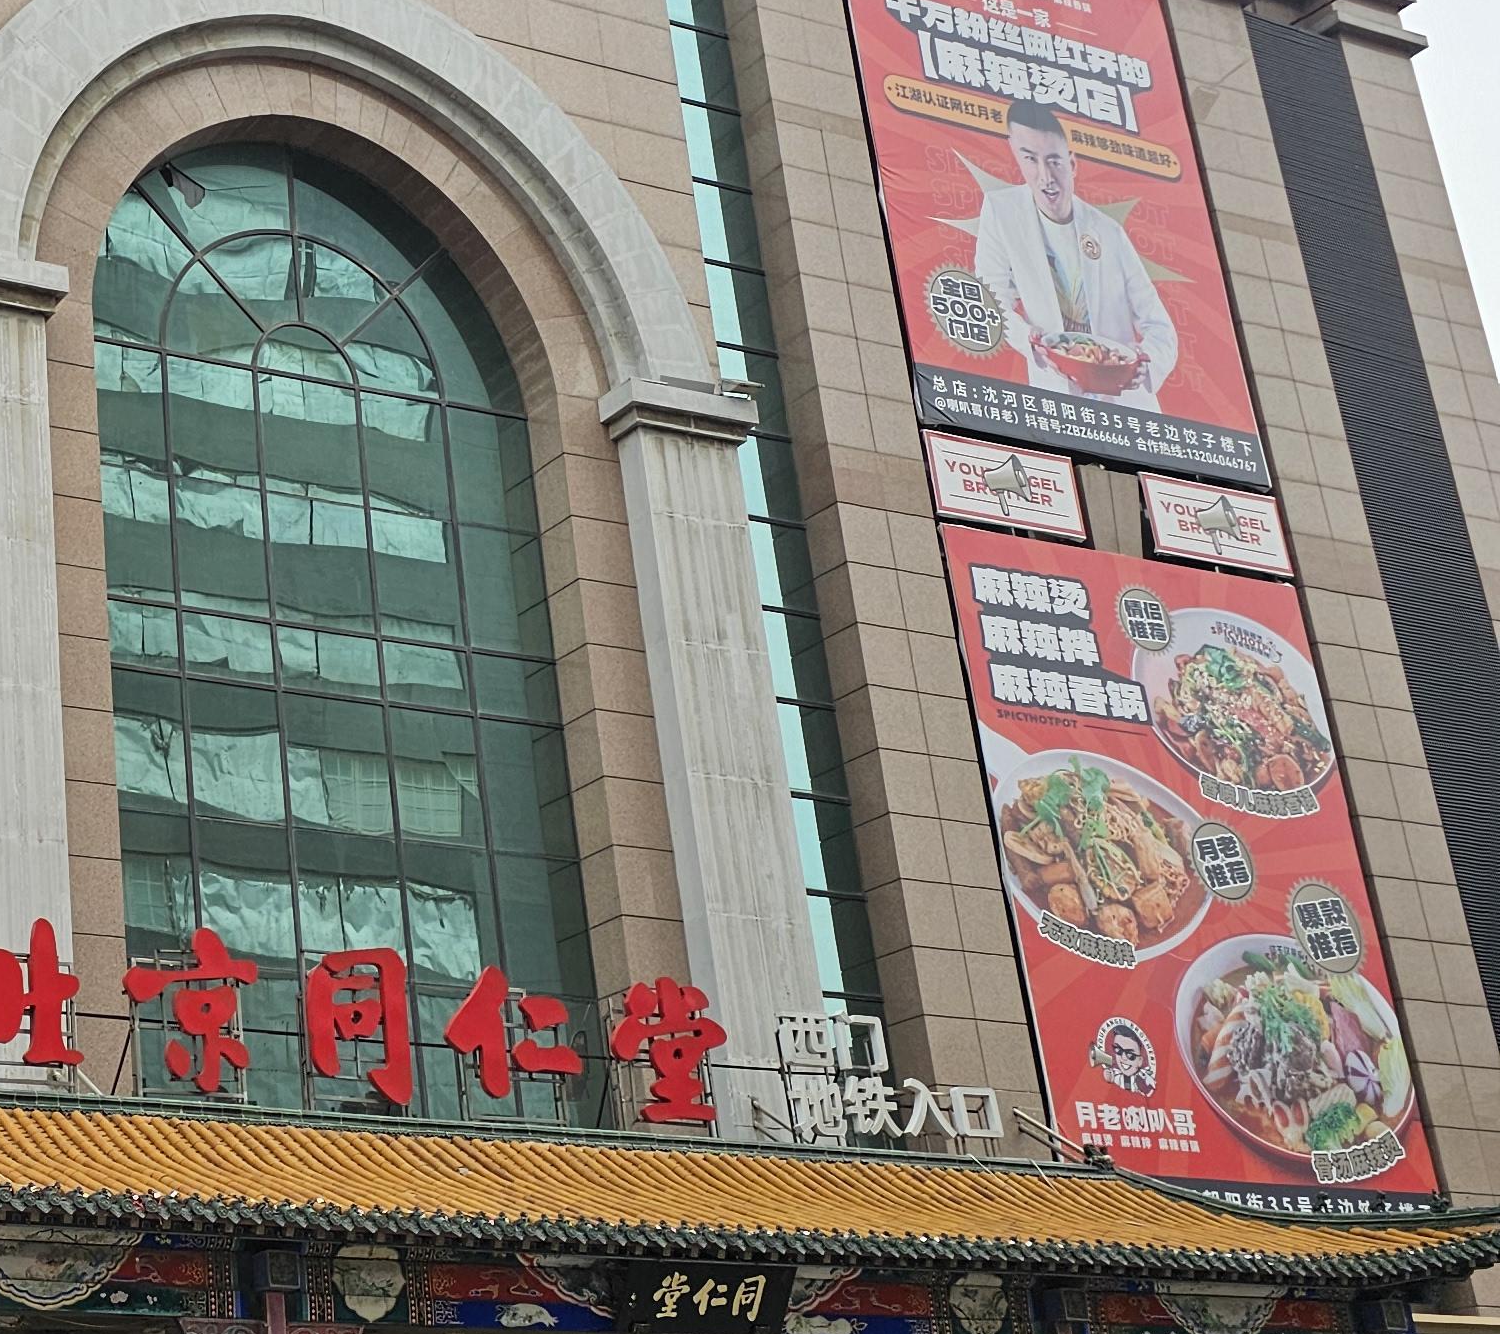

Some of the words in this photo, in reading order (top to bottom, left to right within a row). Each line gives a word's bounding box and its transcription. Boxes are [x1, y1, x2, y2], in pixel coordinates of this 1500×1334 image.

[939, 277, 982, 304] 全国
[932, 296, 1001, 326] 500+
[948, 319, 990, 344] 门店
[971, 567, 1089, 620] 麻辣烫
[980, 615, 1100, 666] 麻辣拌
[1128, 620, 1168, 642] 推荐
[990, 663, 1148, 722] 麻辣香锅
[1196, 835, 1241, 862] 月老
[1204, 860, 1251, 890] 推荐
[1295, 899, 1347, 931] 爆款
[1306, 928, 1359, 961] 推荐
[775, 1011, 888, 1073] 西门
[789, 1076, 1004, 1139] 地铁入口
[1075, 1101, 1196, 1136] 月老喇叭哥
